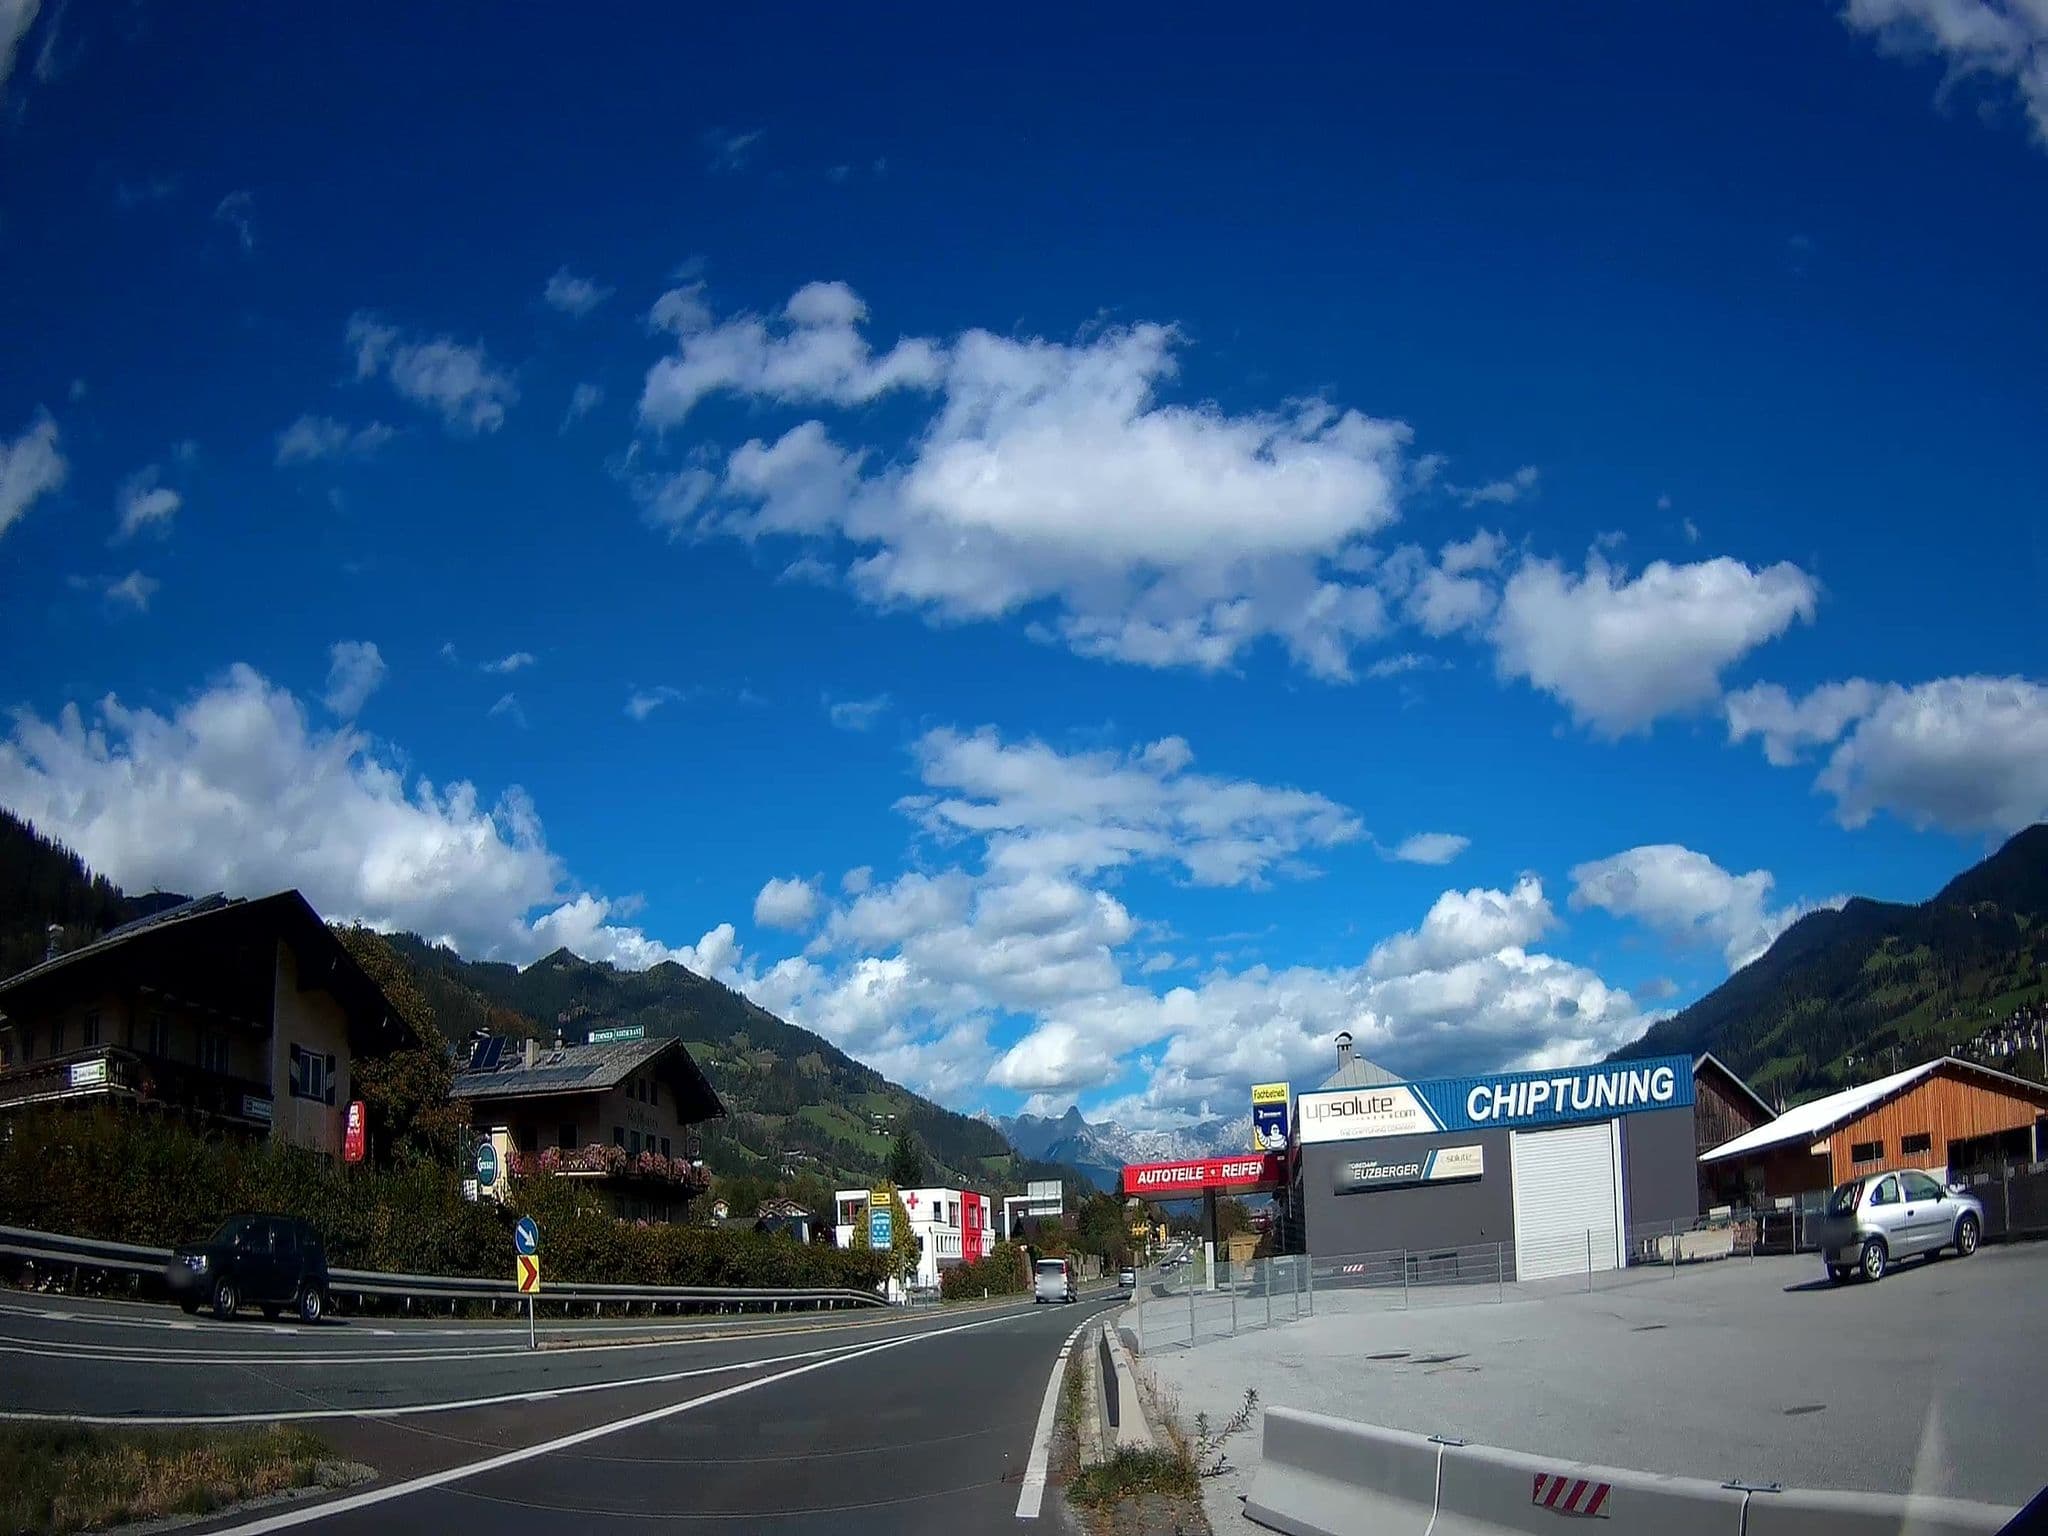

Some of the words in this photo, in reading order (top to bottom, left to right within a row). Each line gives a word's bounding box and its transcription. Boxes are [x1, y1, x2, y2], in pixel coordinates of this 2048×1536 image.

[1466, 1066, 1675, 1121] CHIPTUNING
[1305, 1095, 1393, 1122] upsolute
[1137, 1166, 1205, 1185] AUTOTEILE
[1222, 1161, 1264, 1178] REIFEN
